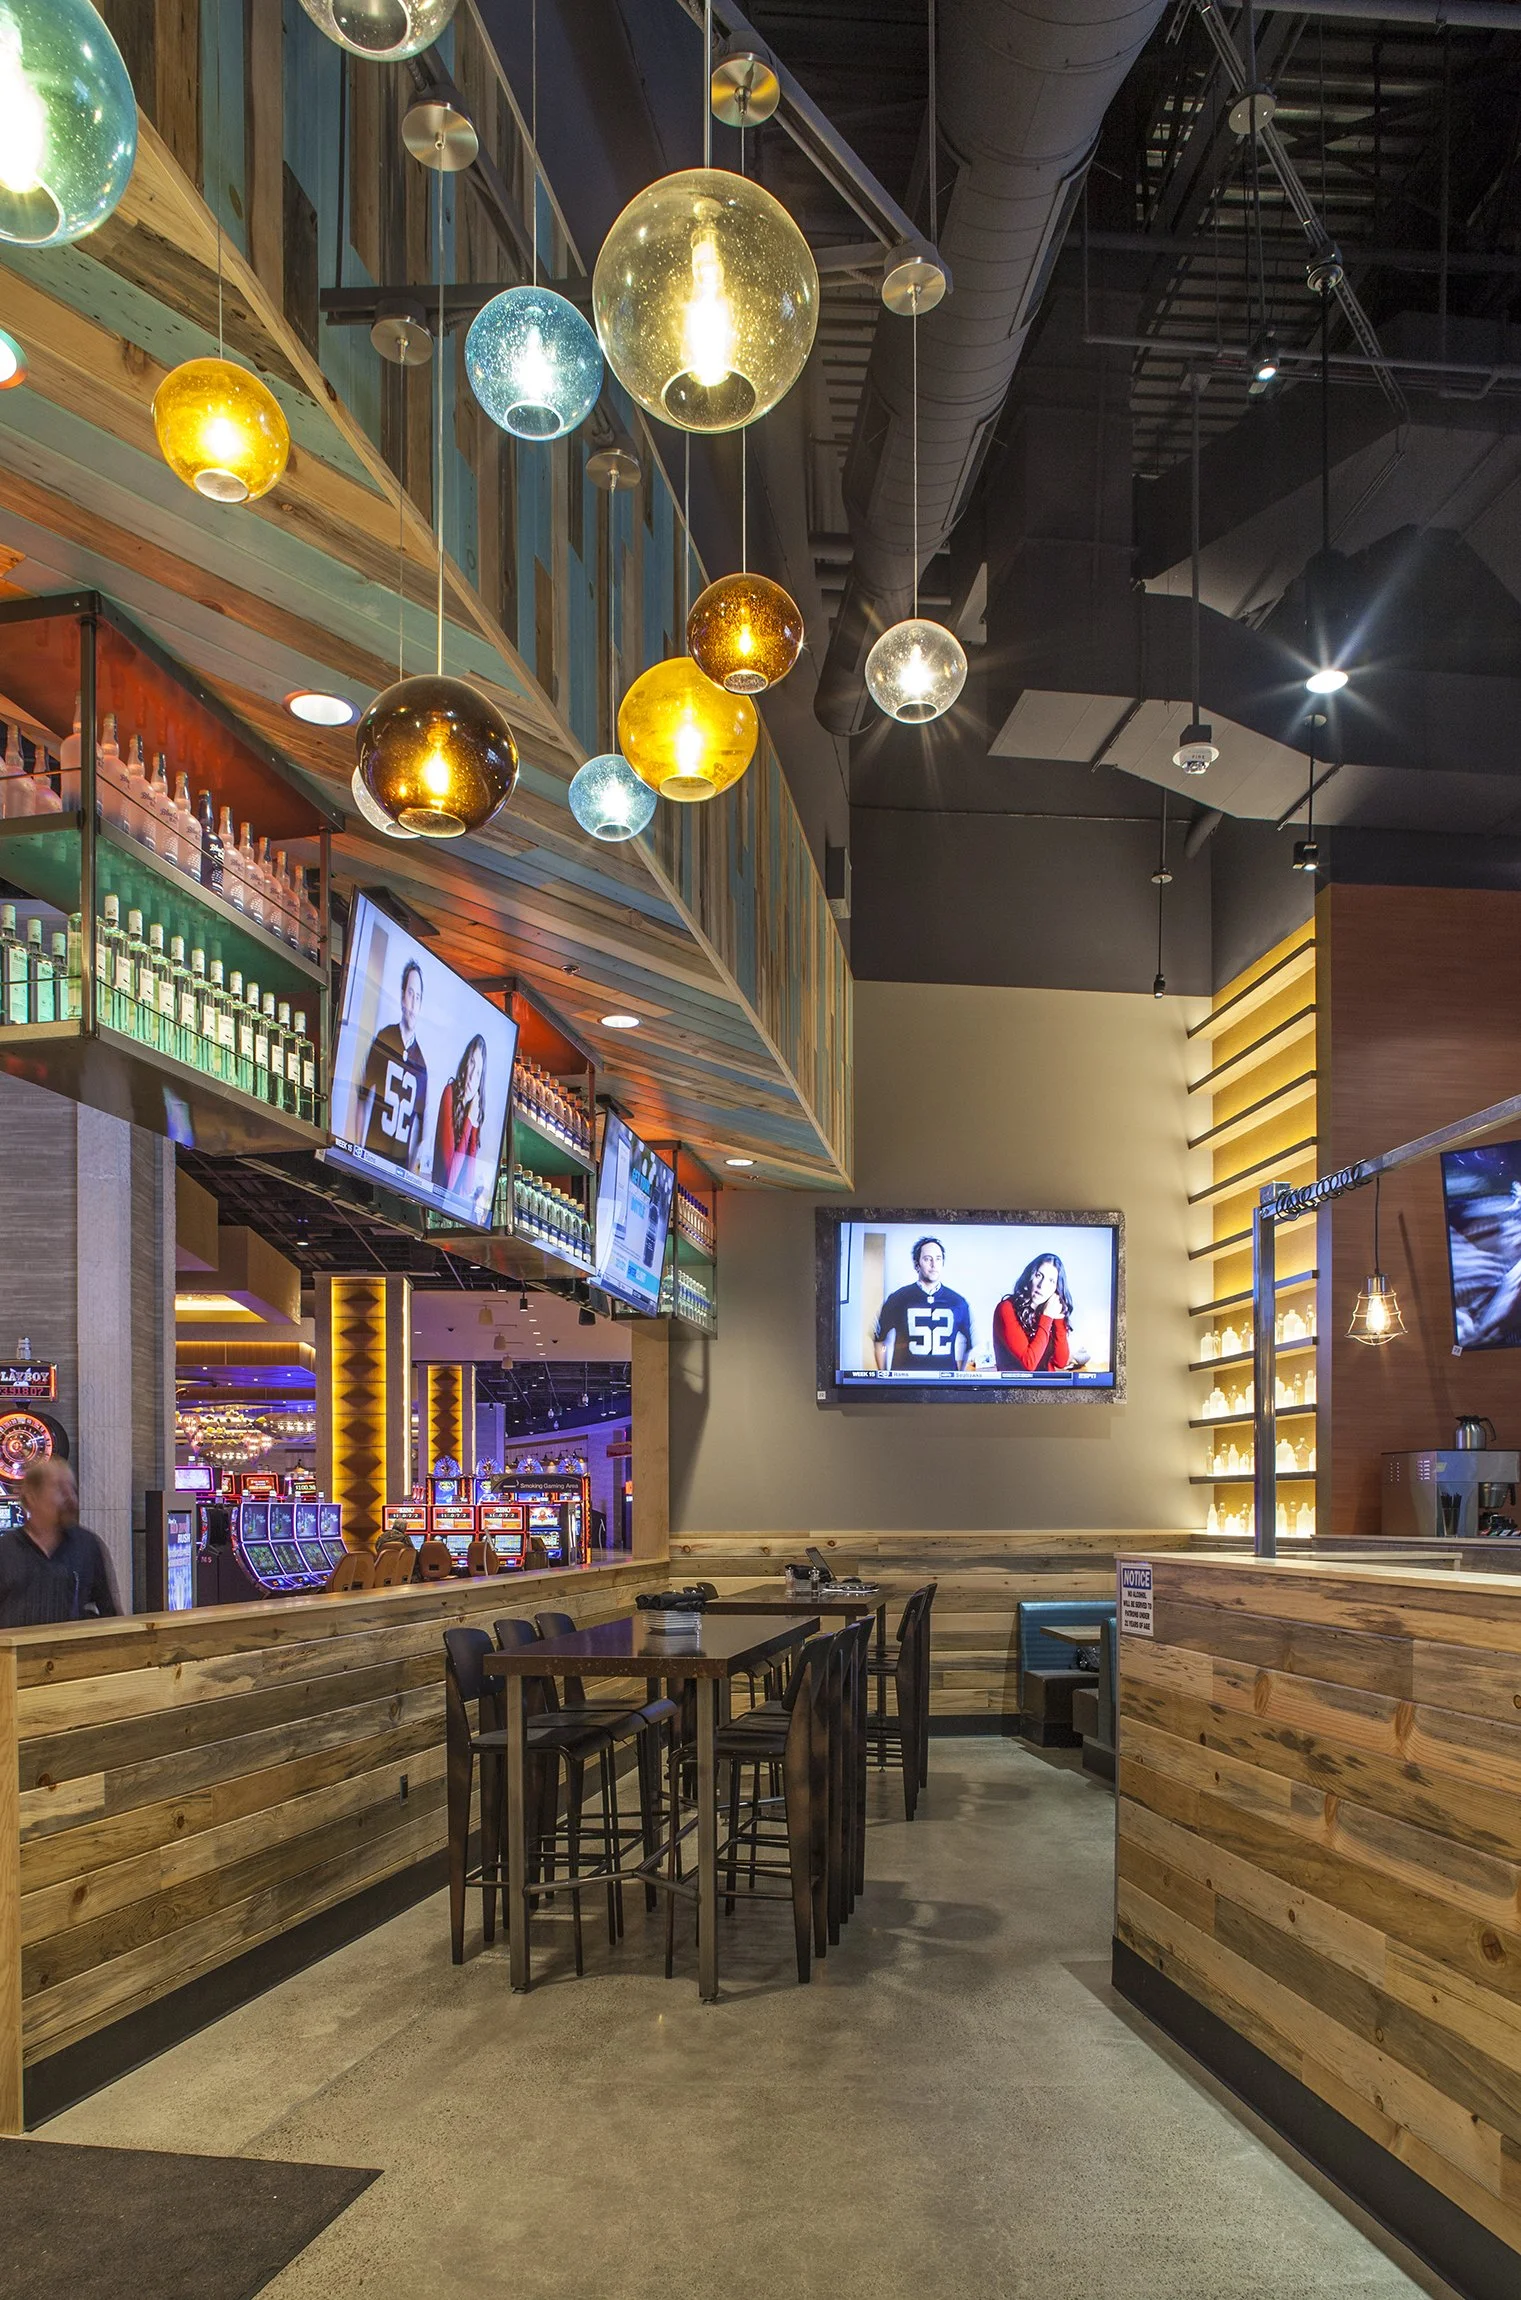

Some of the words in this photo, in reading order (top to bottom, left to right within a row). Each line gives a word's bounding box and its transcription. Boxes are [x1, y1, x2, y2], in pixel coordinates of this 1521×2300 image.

[381, 1059, 417, 1143] 52
[907, 1307, 954, 1356] 52
[0, 1371, 49, 1381] LAYBOY
[1124, 1569, 1150, 1587] NOTICE
[1133, 1591, 1147, 1599] ALCOHOL
[1135, 1601, 1147, 1609] SERVED
[1125, 1609, 1138, 1618] PATRONS
[1139, 1611, 1150, 1620] UNDER
[1129, 1620, 1138, 1628] YEARS
